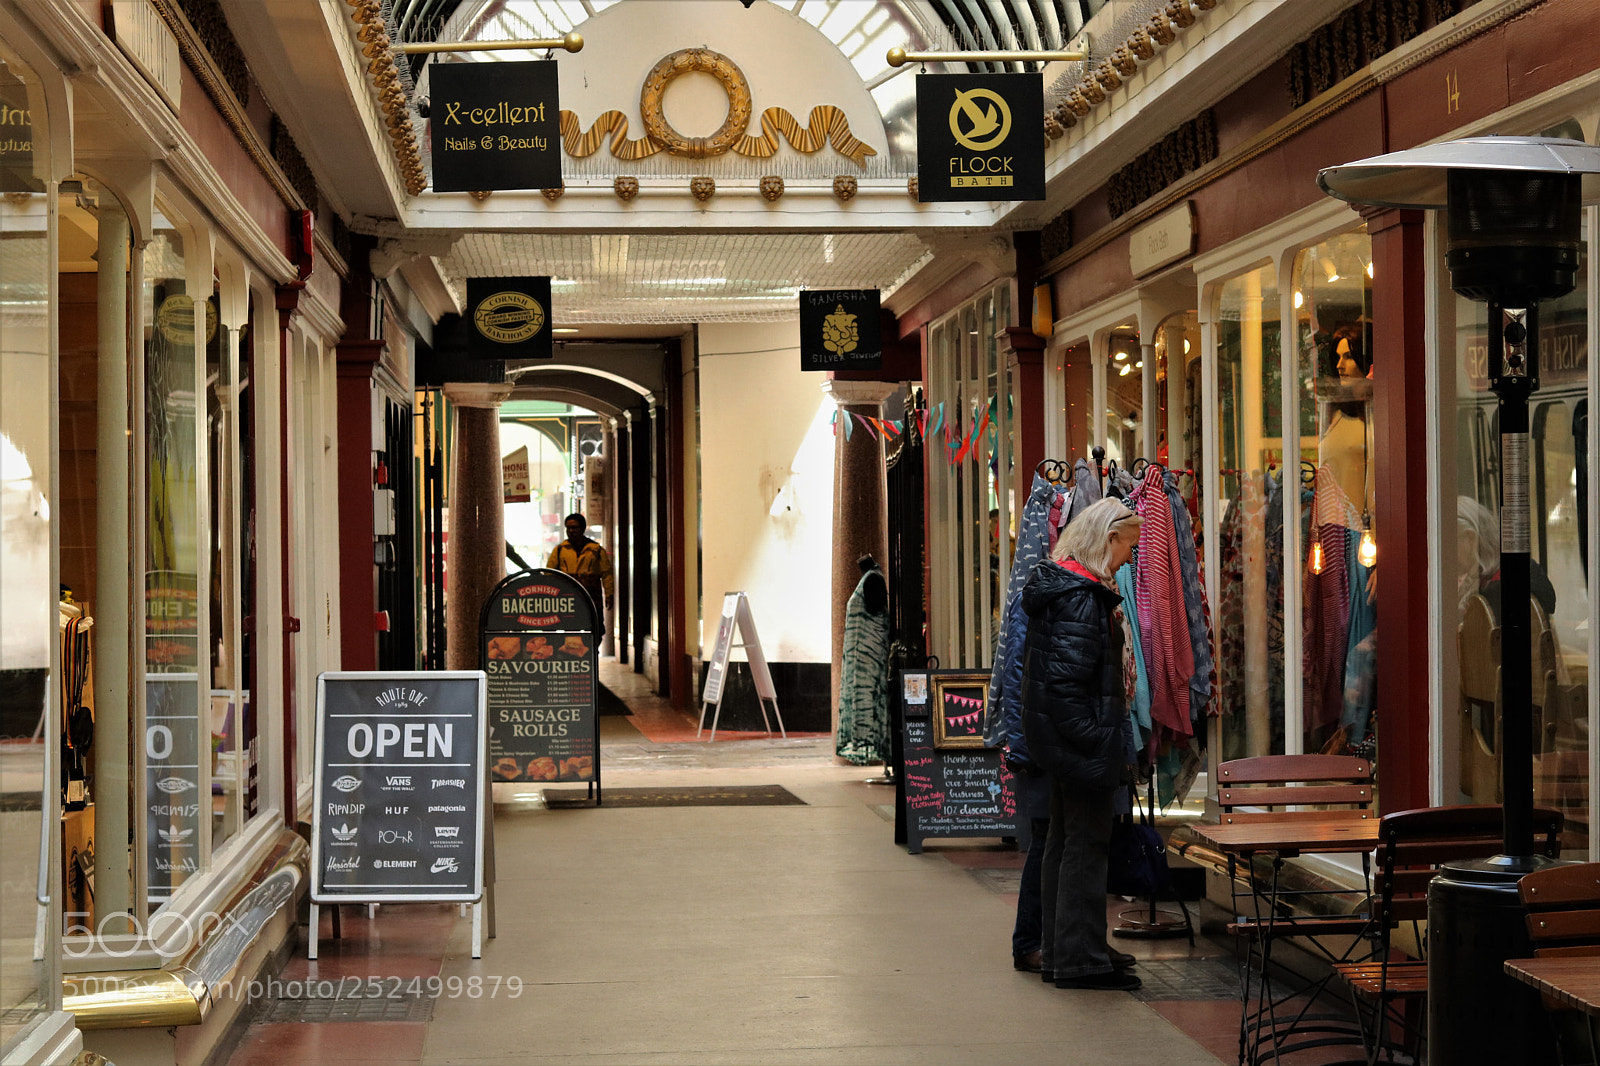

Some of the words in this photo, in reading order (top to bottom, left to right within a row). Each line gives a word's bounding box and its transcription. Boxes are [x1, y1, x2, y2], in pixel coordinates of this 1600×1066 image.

[1446, 66, 1460, 114] 14
[444, 101, 545, 127] X-cellent
[445, 137, 477, 151] Nails
[481, 135, 494, 150] &
[498, 135, 547, 152] Beauty
[950, 156, 1013, 174] FLOCK
[956, 176, 1007, 187] BATH
[488, 295, 528, 306] CORNISH
[808, 292, 867, 306] GANESHA
[486, 327, 533, 340] BAKEHOUSE
[812, 353, 845, 363] SILVER
[519, 586, 558, 597] CORNISH
[502, 597, 575, 614] BAKEHOUSE
[519, 616, 542, 626] SINCE
[487, 660, 590, 674] SAVOURIES
[375, 687, 406, 707] ROUTE
[408, 688, 429, 707] ONE
[499, 709, 581, 723] SAUSAGE
[512, 723, 568, 737] ROLLS
[347, 722, 453, 758] OPEN
[942, 754, 968, 764] thank
[969, 755, 985, 769] you
[942, 767, 954, 778] for
[956, 767, 999, 780] supporting
[385, 776, 412, 786] VANS
[430, 779, 466, 790] THRASHER
[945, 780, 961, 788] our
[964, 778, 989, 788] small
[949, 788, 985, 799] business
[385, 806, 409, 815] HUF
[428, 804, 466, 813] patagonia
[942, 805, 958, 816] 10%
[959, 804, 1001, 815] discount
[327, 855, 361, 872] Herschel
[383, 860, 417, 868] ELEMENT
[436, 857, 456, 866] NIKE
